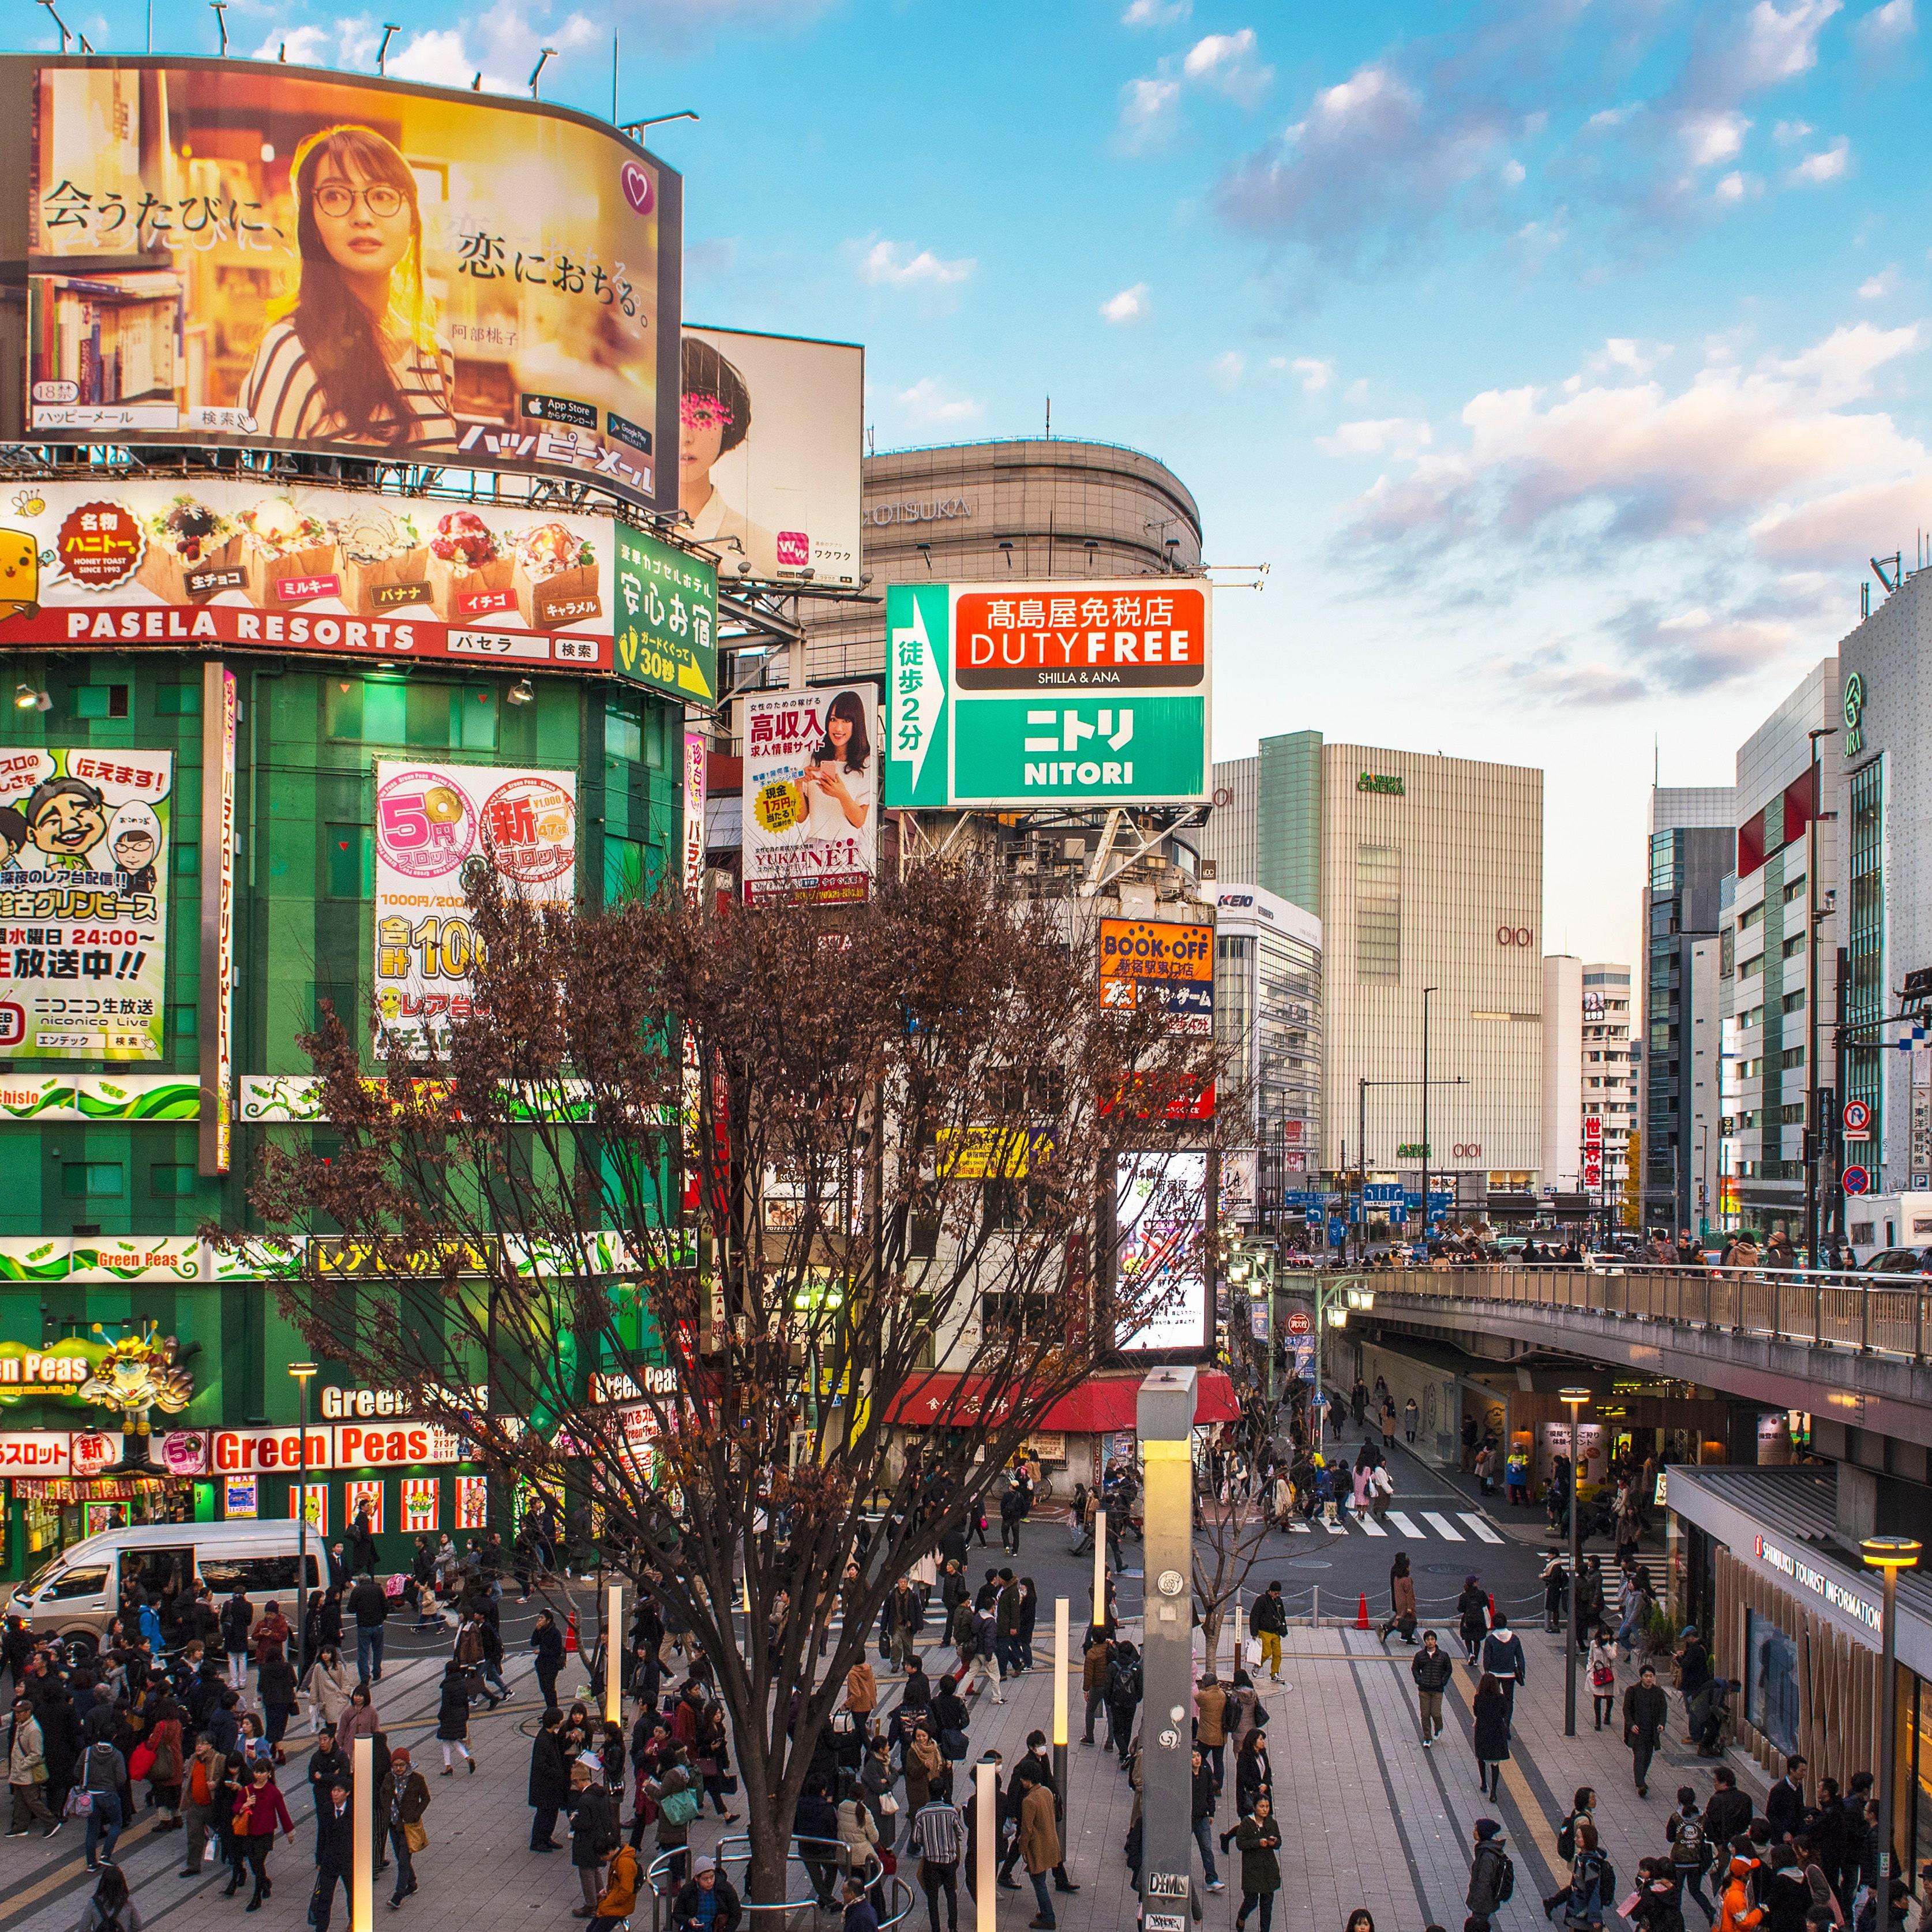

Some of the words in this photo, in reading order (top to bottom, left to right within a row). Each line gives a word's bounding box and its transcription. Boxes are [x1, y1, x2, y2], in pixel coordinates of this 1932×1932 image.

[44, 179, 285, 238] 会うたびに、
[457, 232, 647, 328] 恋におちる。
[452, 324, 518, 346] 阿部桃子
[37, 384, 75, 400] 18禁
[548, 399, 566, 412] App
[569, 403, 590, 414] Store
[39, 410, 133, 424] ハッピーメール
[202, 410, 234, 425] 検索
[458, 425, 653, 493] ハッピーメール
[873, 497, 971, 526] OTSUKA
[80, 513, 118, 531] 名物
[815, 550, 851, 561] ワクワク
[192, 572, 241, 590] 生チョコ
[284, 580, 334, 595] ミルキー
[381, 586, 421, 602] バナナ
[468, 593, 506, 609] イチゴ
[546, 600, 597, 617] キャラメル
[621, 572, 712, 648] 安心お宿
[67, 612, 217, 637] PASELA
[238, 613, 414, 650] RESORTS
[457, 636, 512, 652] パセラ
[562, 643, 591, 658] 検索
[642, 632, 689, 662] ガードくぐって
[640, 648, 675, 682] 30秒
[1038, 672, 1076, 684] SHILLA
[1079, 672, 1089, 683] &
[1091, 671, 1120, 683] ANA
[751, 697, 821, 712] 女性のための稼げる
[898, 640, 923, 751] 徒歩2分
[751, 709, 825, 743] 高収入
[1025, 709, 1134, 752] ニトリ
[751, 739, 825, 757] 求人情報サイト
[1025, 762, 1134, 785] NITORI
[766, 785, 787, 799] 現金
[1357, 781, 1405, 796] CINEMA
[488, 794, 539, 849] 新
[1217, 895, 1254, 907] KEIO
[35, 998, 153, 1015] ニコニコ生放送
[40, 1016, 108, 1026] niconico
[117, 1018, 149, 1026] Live
[39, 1036, 88, 1046] エンデック
[115, 1036, 138, 1046] 検索
[1585, 1117, 1601, 1187] 世界堂
[99, 1253, 140, 1266] Green
[145, 1252, 178, 1266] Peas
[1291, 1320, 1307, 1329] 消火栓
[23, 1353, 89, 1382] Peas
[80, 1435, 104, 1461] 新
[216, 1433, 326, 1470] Green
[343, 1427, 427, 1463] Peas
[1762, 1541, 1795, 1576] SHINJUKU
[1795, 1560, 1825, 1595] TOURIST
[1825, 1579, 1882, 1634] INFORMATION
